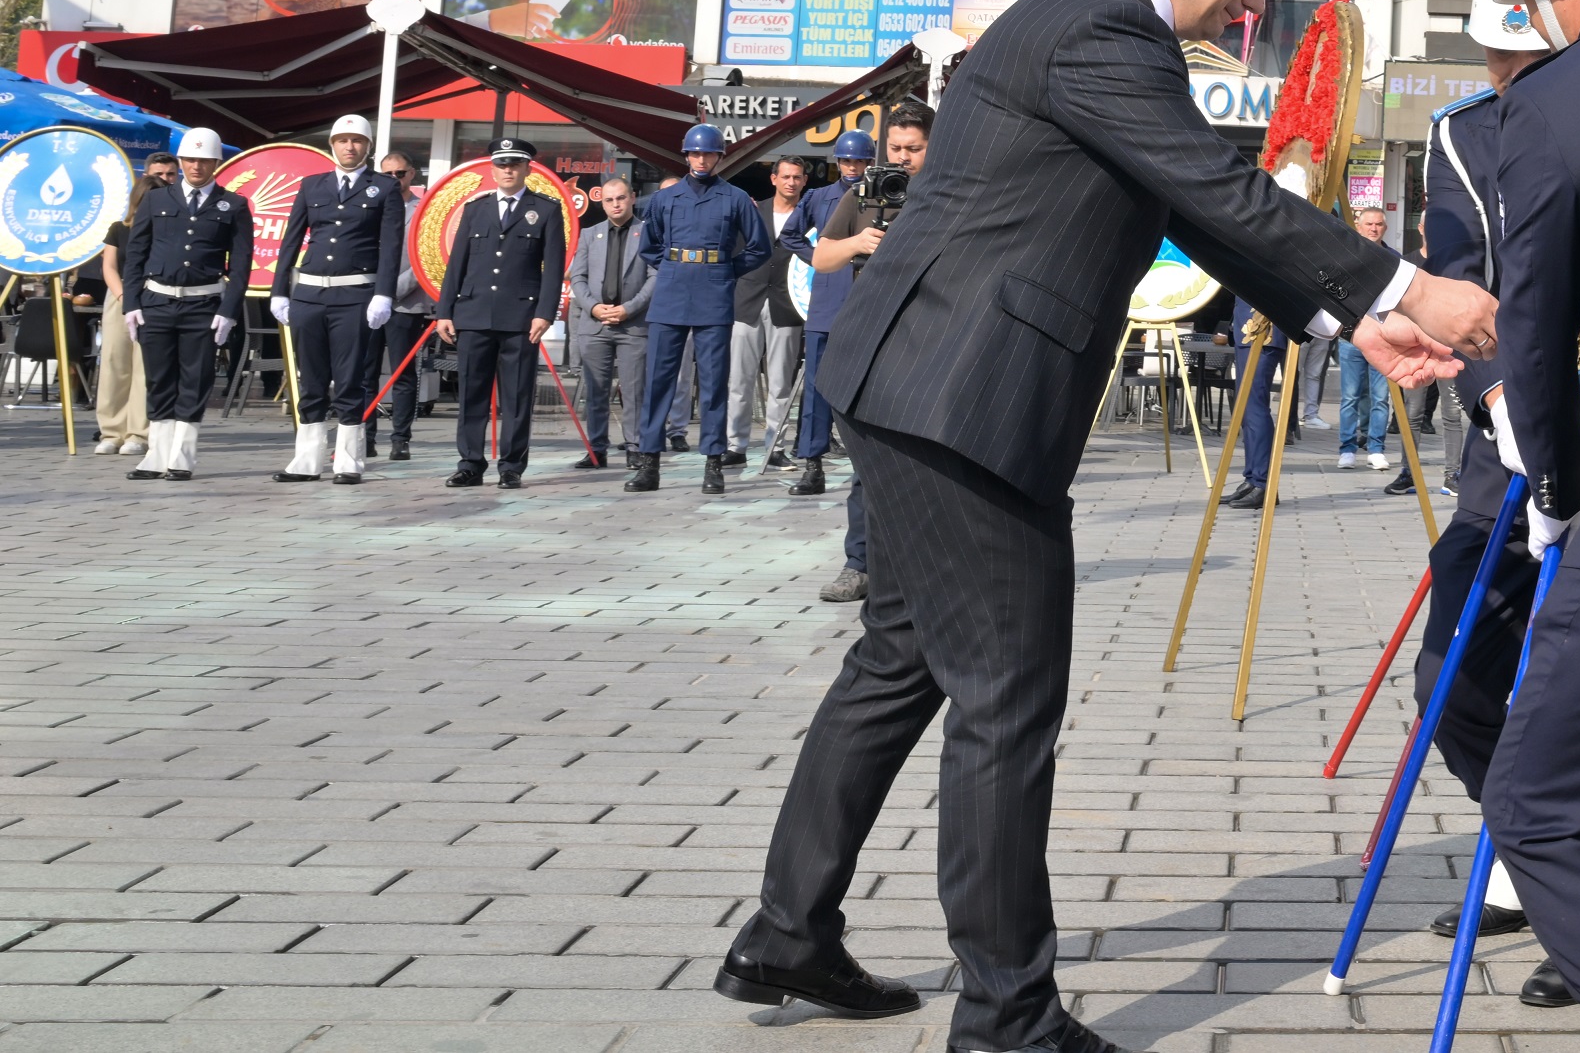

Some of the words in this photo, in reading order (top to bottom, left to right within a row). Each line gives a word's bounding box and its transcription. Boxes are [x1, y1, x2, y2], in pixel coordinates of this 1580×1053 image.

[733, 15, 790, 25] PEGASUS
[808, 13, 844, 25] YURT
[847, 10, 868, 28] İÇİ
[879, 12, 904, 31] 0533
[905, 13, 924, 32] 602
[925, 13, 936, 31] 41
[936, 14, 950, 30] 99
[968, 13, 999, 24] QATA
[801, 26, 831, 41] TÜM
[835, 28, 874, 45] UÇAK
[733, 42, 785, 55] Emirates
[802, 41, 869, 58] BİLETLERİ
[1390, 74, 1436, 96] BİZİ
[689, 94, 798, 116] AREKET
[1351, 185, 1380, 195] SPOR
[5, 189, 26, 234] ESENYURT
[54, 194, 101, 241] BAŞKANLIĞI
[27, 209, 73, 222] DEVA
[252, 216, 289, 240] CH
